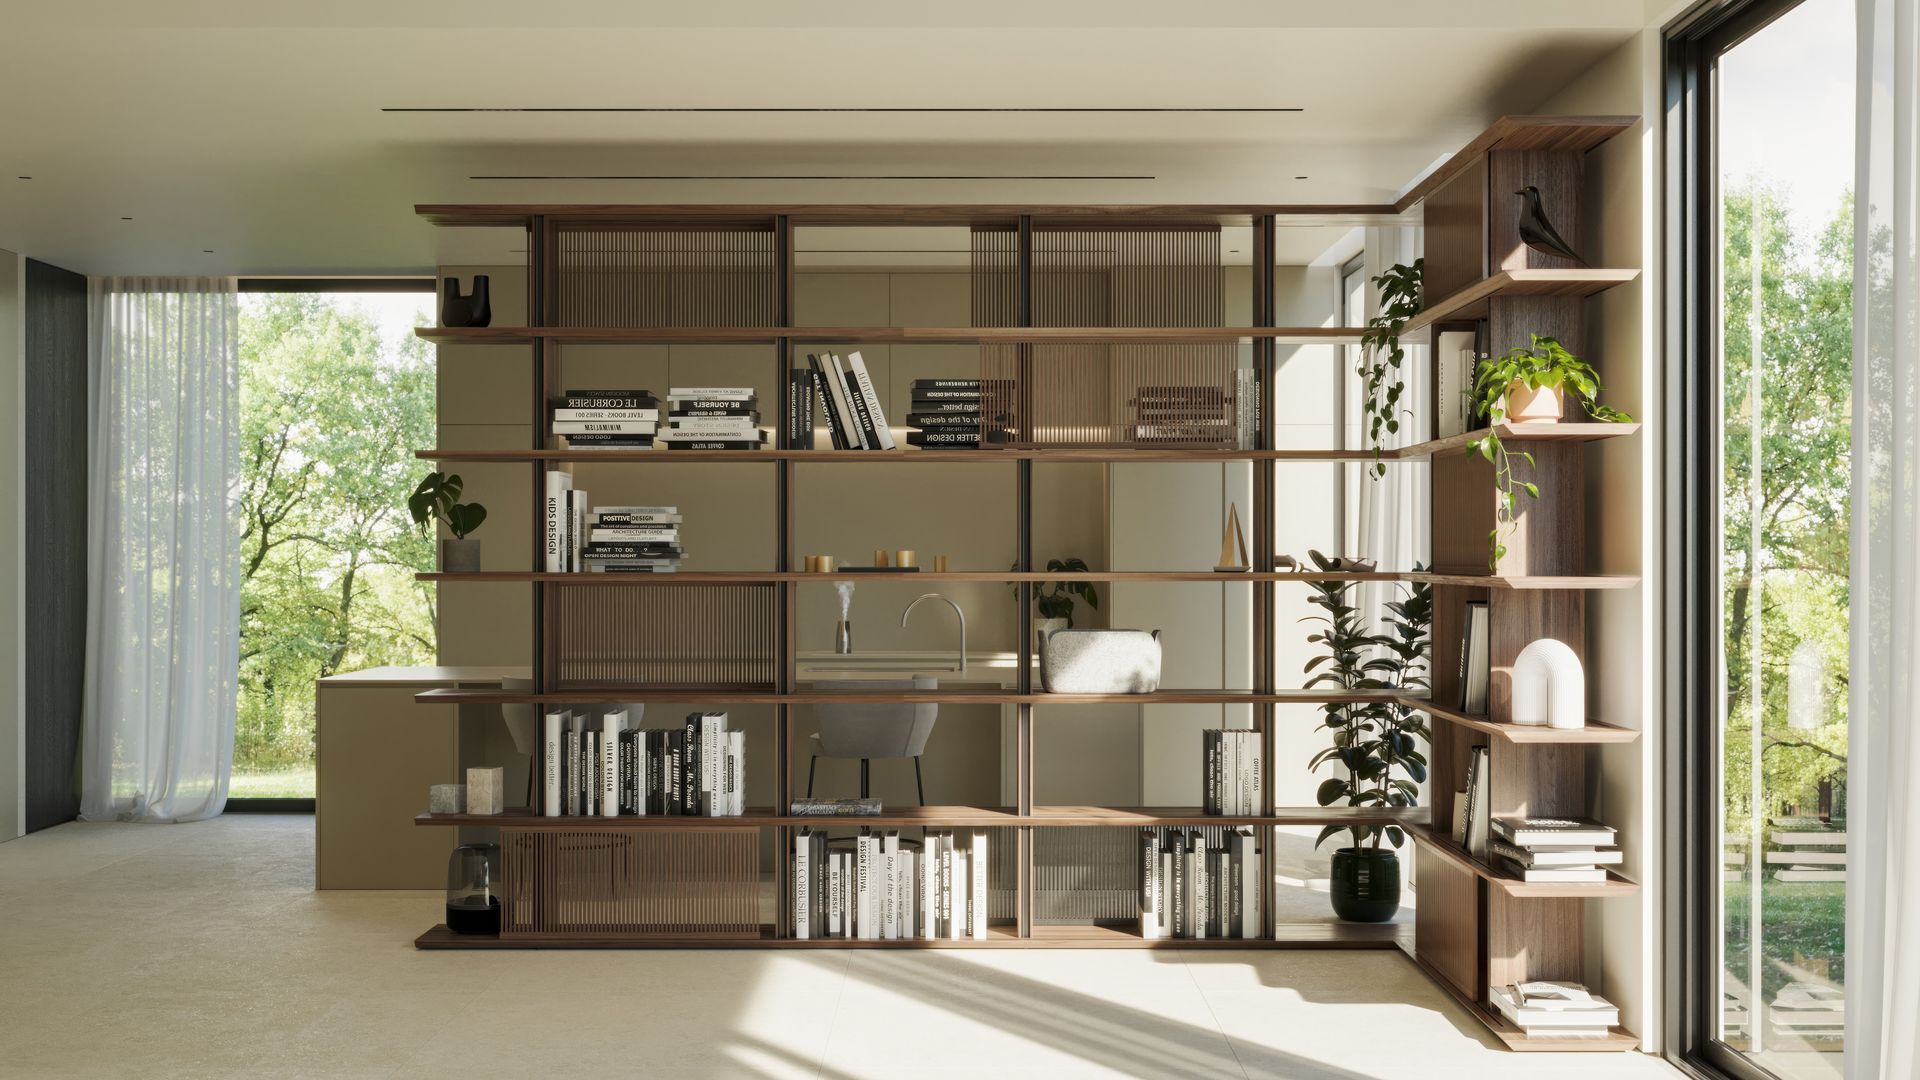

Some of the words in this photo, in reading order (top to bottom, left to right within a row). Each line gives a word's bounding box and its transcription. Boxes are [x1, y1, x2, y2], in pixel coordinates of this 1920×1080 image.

[548, 497, 556, 521] KIDS
[548, 522, 556, 555] DESIGN
[546, 741, 556, 764] design
[798, 855, 806, 867] LE
[886, 856, 894, 872] Day
[832, 871, 838, 882] BE
[888, 873, 894, 882] of
[797, 870, 806, 924] CORBUSIER
[886, 898, 894, 924] design
